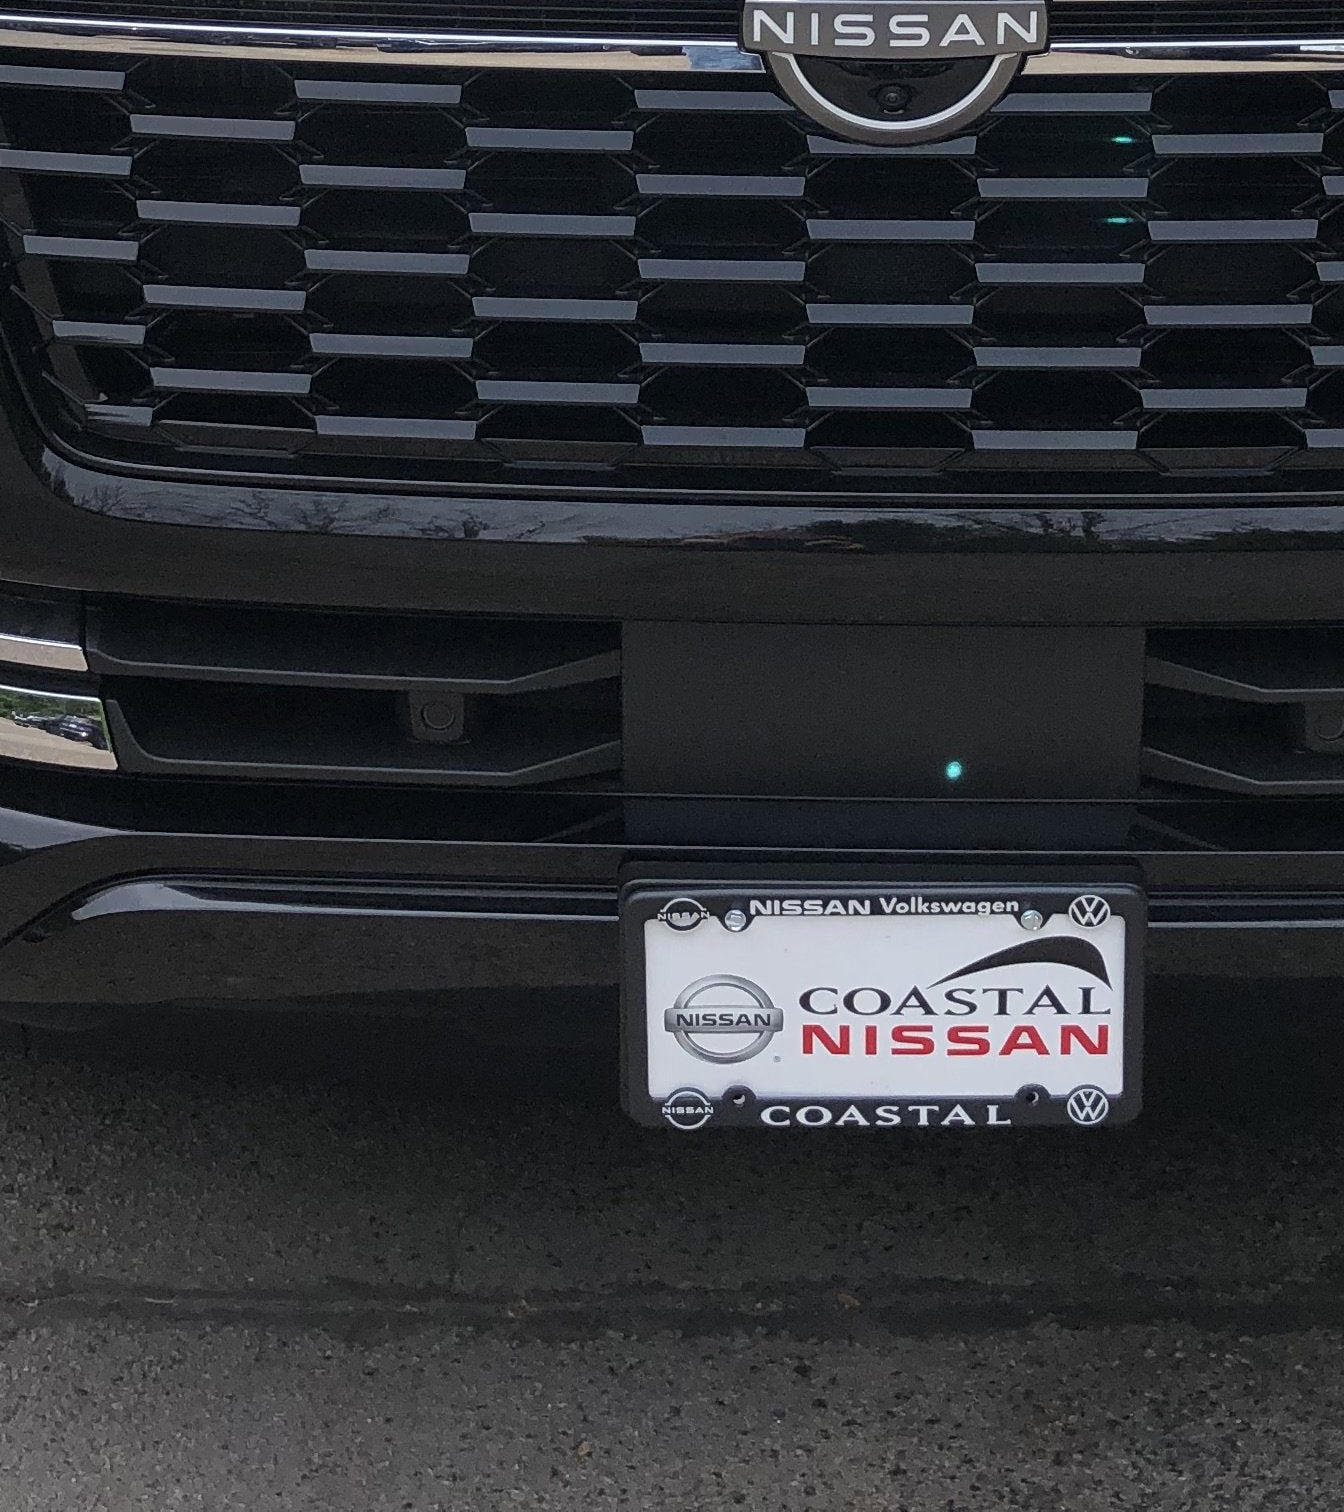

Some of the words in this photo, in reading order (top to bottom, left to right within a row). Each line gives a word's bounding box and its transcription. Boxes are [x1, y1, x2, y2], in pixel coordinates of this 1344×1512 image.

[753, 9, 1038, 48] NISSAN
[657, 911, 710, 921] NISSAN
[749, 899, 871, 916] NISSAN
[879, 896, 1019, 916] Volkswagen
[798, 984, 1112, 1016] COASTAL
[675, 1012, 772, 1027] NISSAN
[801, 1024, 1109, 1056] NISSAN
[661, 1106, 714, 1114] NISSAN
[760, 1104, 1012, 1127] COASTAL
